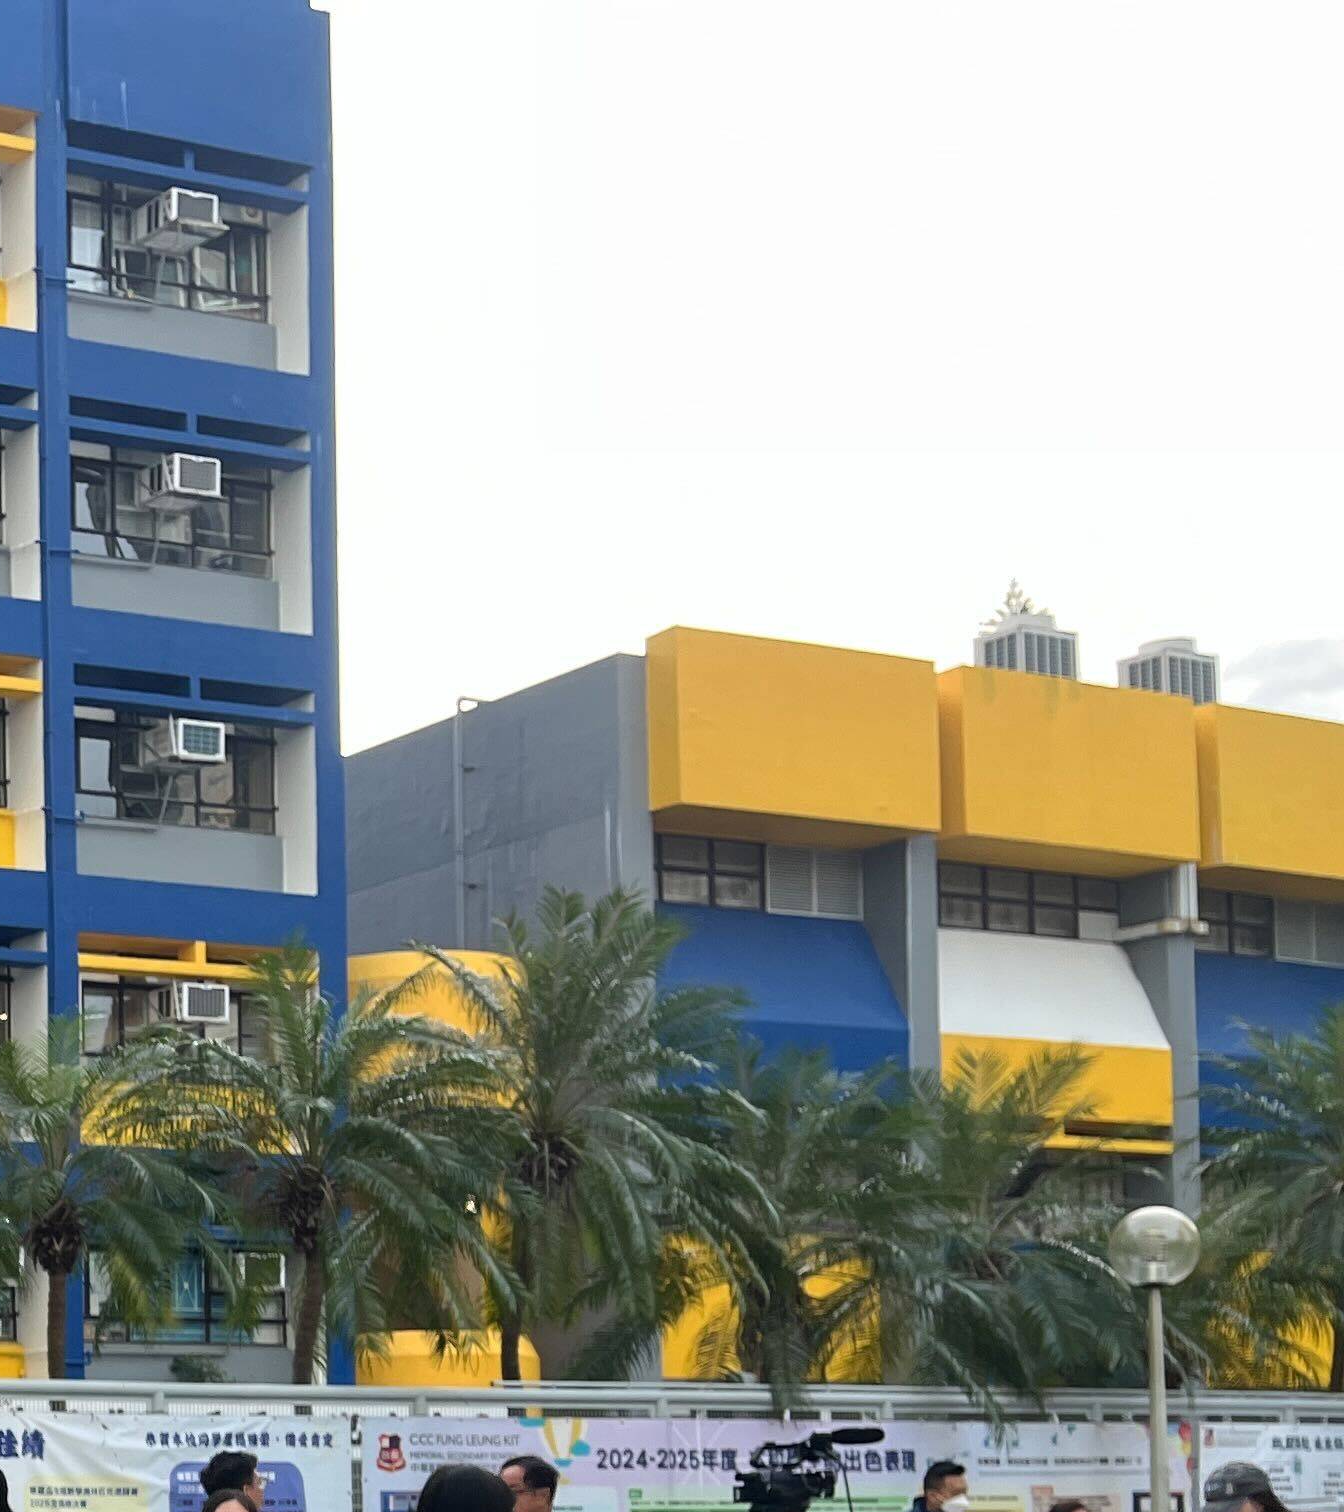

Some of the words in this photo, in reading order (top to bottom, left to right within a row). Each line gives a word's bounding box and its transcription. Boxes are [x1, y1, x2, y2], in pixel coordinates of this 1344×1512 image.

[409, 1433, 433, 1446] CCC
[436, 1433, 463, 1446] FUNG
[466, 1433, 501, 1446] LEUNG
